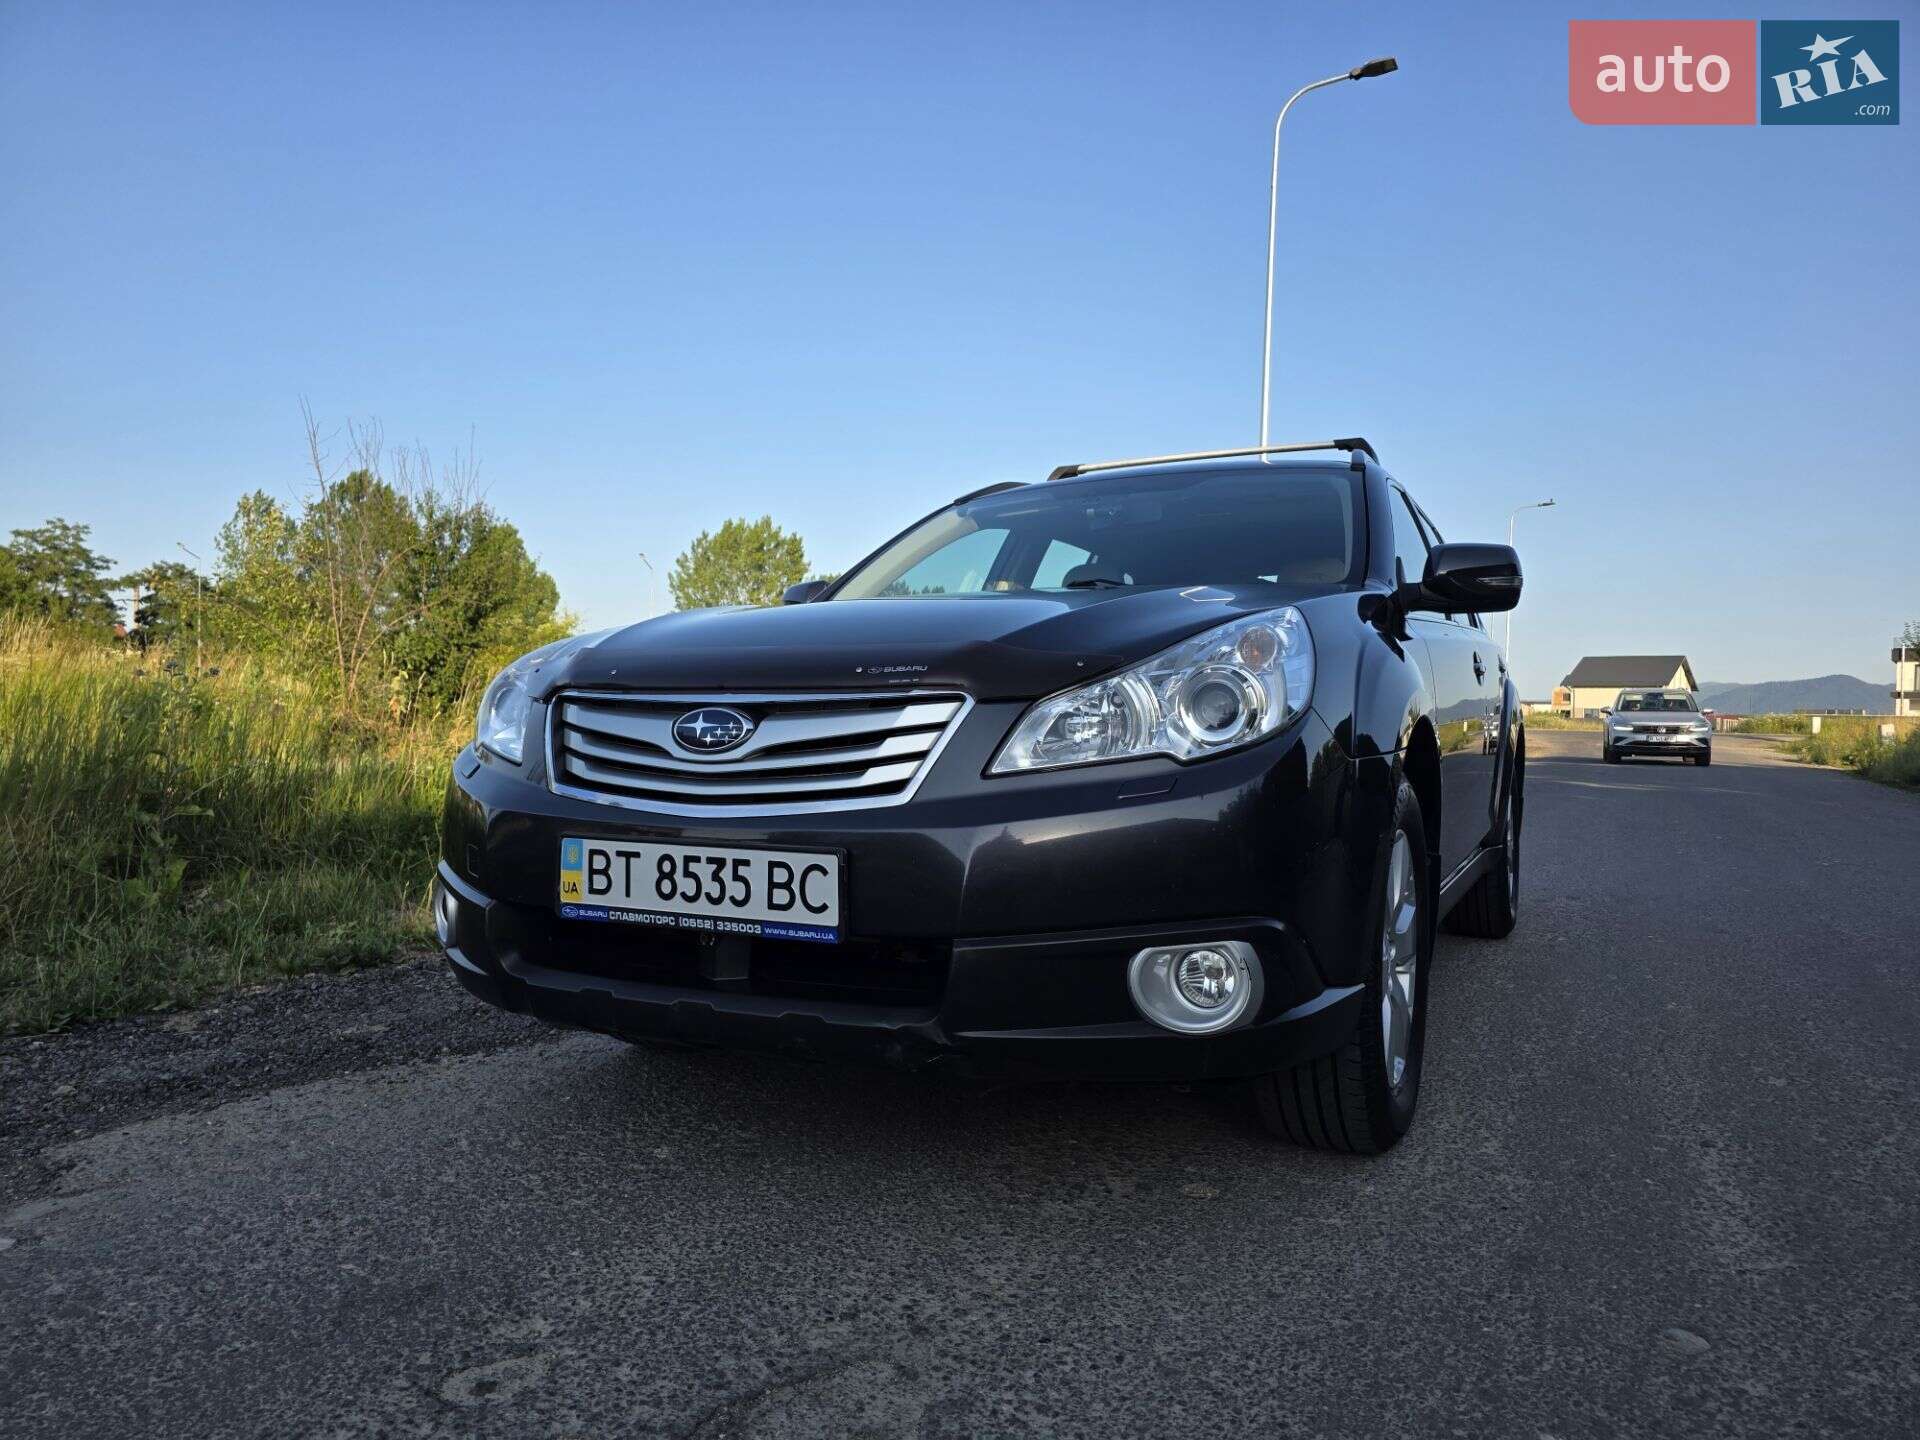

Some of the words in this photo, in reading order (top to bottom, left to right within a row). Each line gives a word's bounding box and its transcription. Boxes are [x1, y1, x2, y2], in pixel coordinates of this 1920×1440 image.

[883, 665, 928, 673] SUBARU
[562, 881, 579, 894] UA
[588, 848, 641, 898] BT
[655, 853, 751, 908] 8535
[767, 860, 830, 914] BC
[579, 909, 608, 918] SUBARU
[716, 920, 762, 934] 335003
